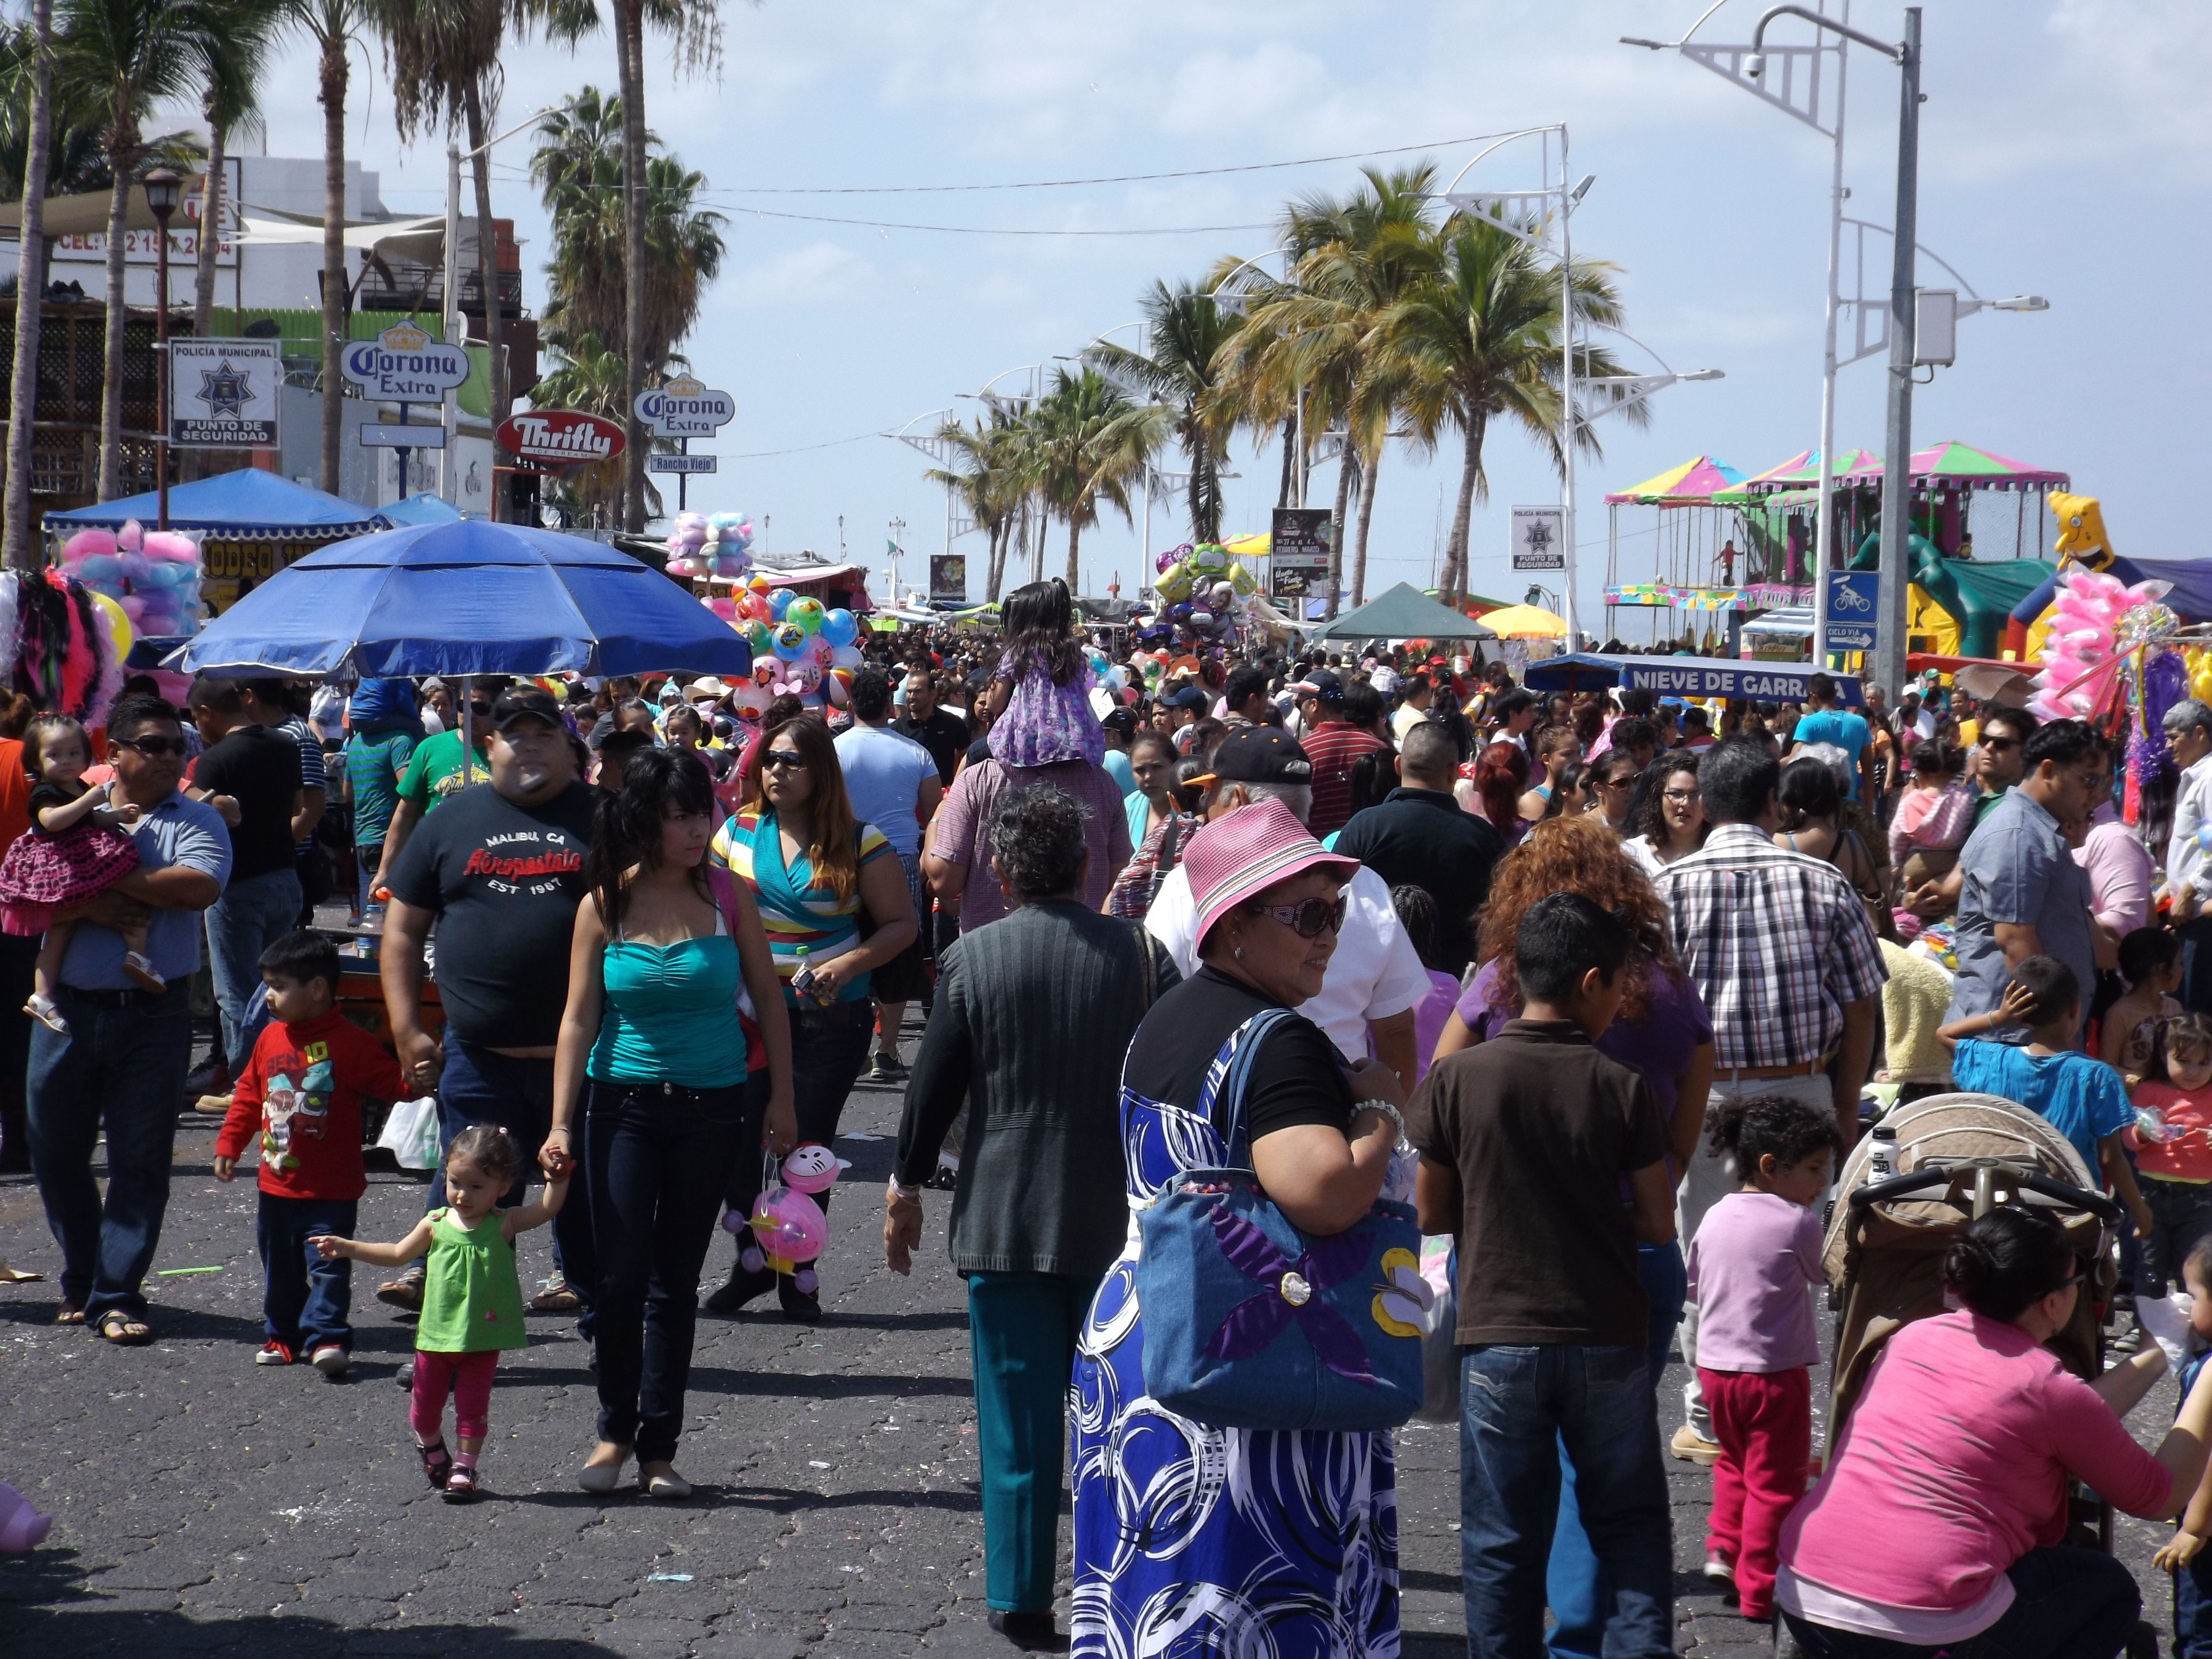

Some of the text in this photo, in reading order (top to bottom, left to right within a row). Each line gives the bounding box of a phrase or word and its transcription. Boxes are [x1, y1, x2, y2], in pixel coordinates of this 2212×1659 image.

[176, 346, 272, 357] POLICÍA MUNICIPAL
[350, 346, 457, 379] Corona
[380, 375, 436, 395] Extra
[642, 394, 726, 420] Corona
[187, 421, 263, 431] PUNTO DE
[666, 416, 709, 431] Extra
[181, 431, 268, 441] SEGURIDAD
[513, 417, 612, 458] Thrifty
[1633, 670, 1846, 700] NIEVE DE GARRA
[546, 832, 565, 845] CA
[487, 878, 562, 895] EST 1987
[266, 1041, 328, 1073] BEN 10
